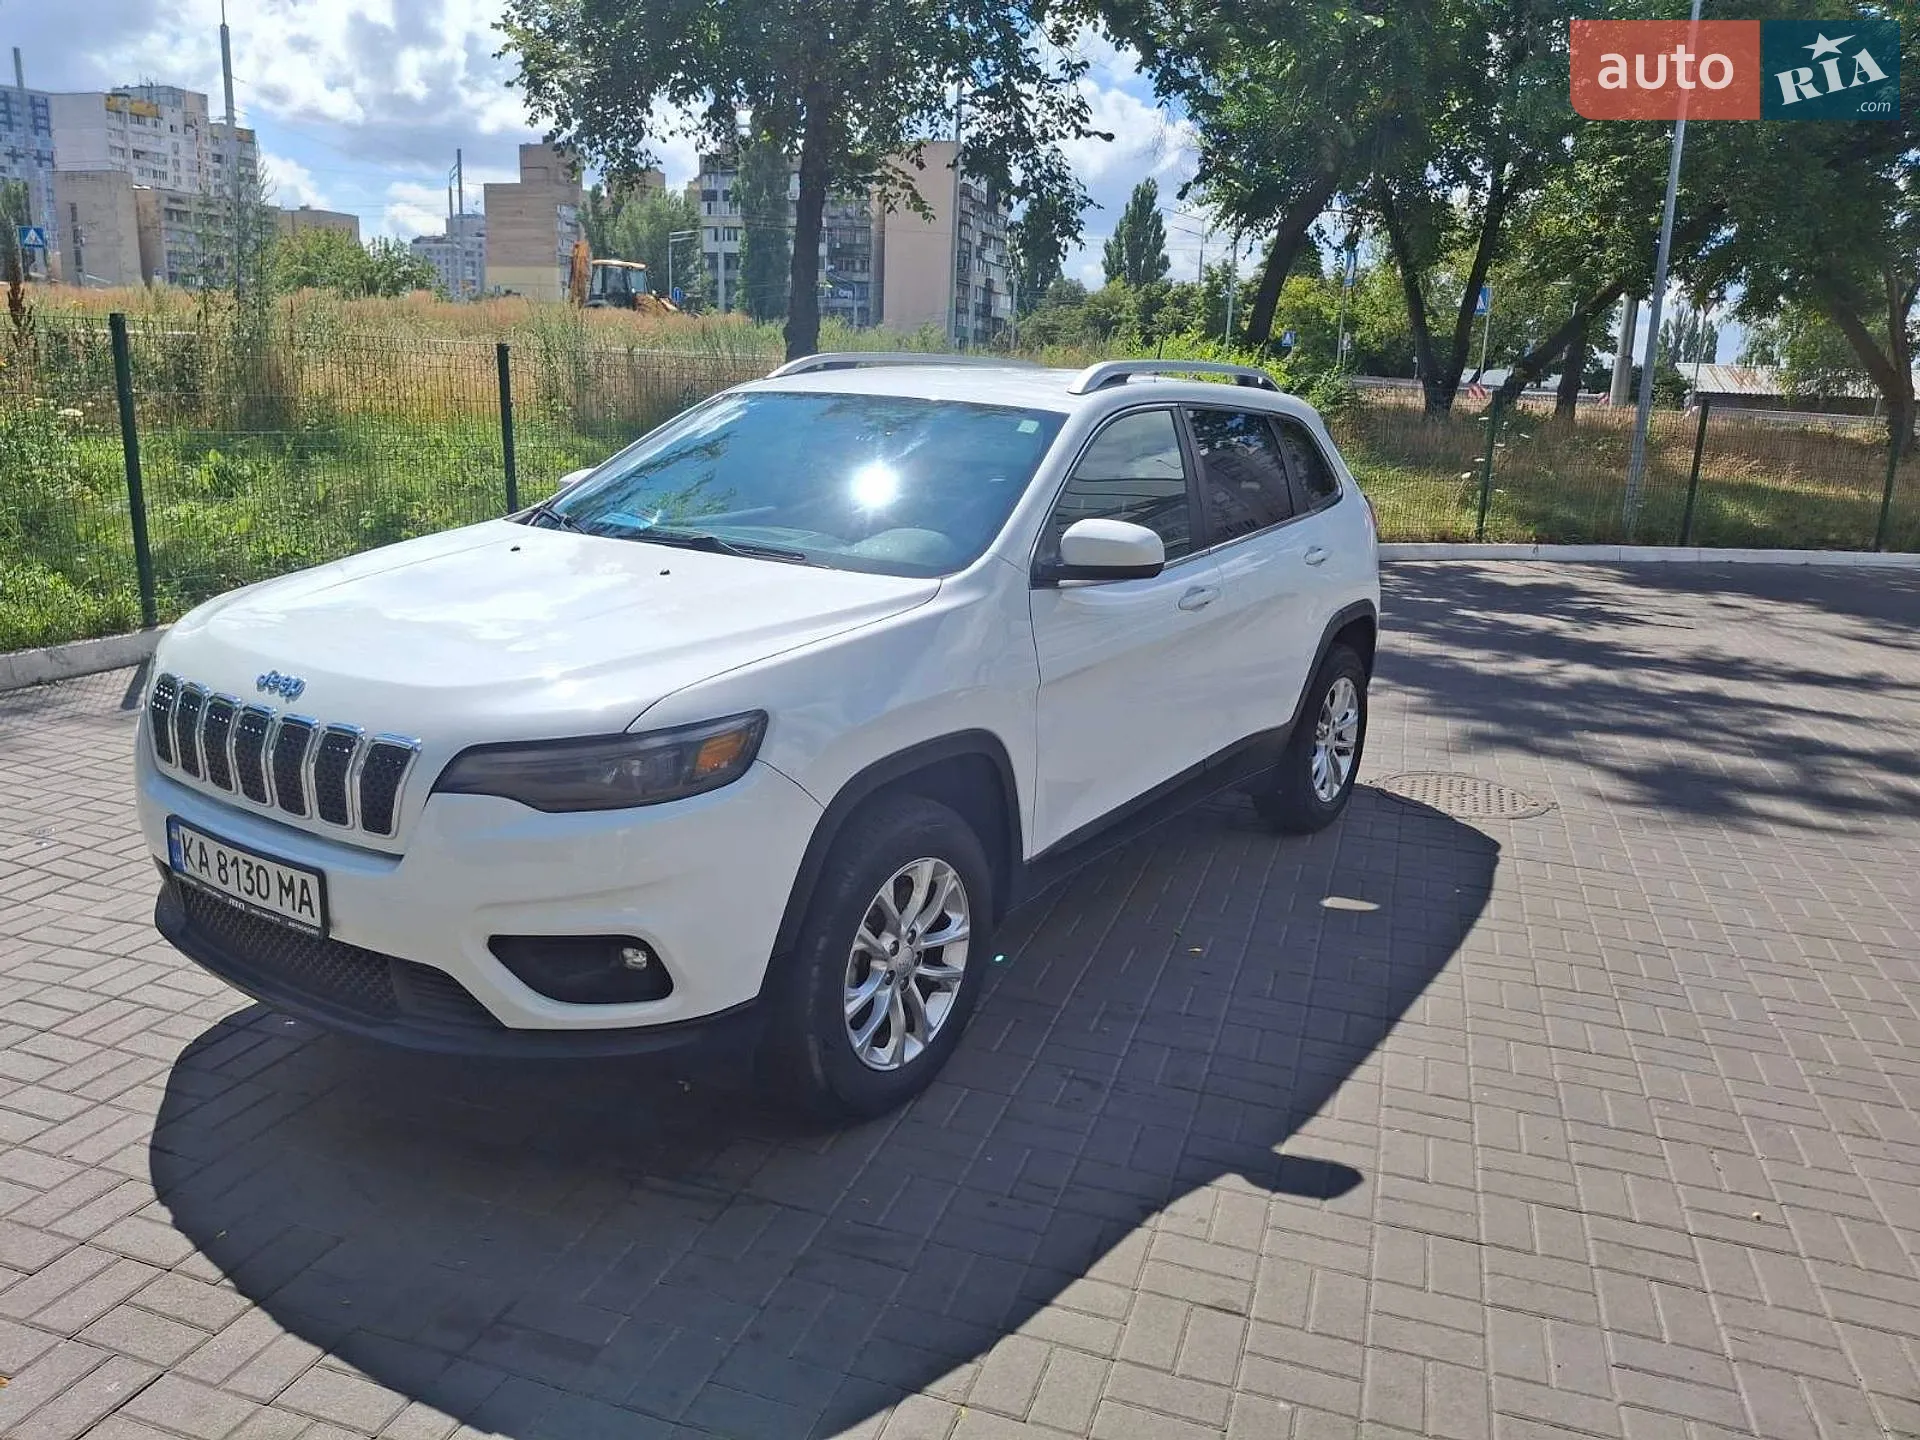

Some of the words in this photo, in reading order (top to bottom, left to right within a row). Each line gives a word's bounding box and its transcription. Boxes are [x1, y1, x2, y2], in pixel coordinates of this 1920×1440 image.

[182, 833, 211, 878] KA
[217, 850, 270, 900] 8130
[277, 870, 315, 918] MA
